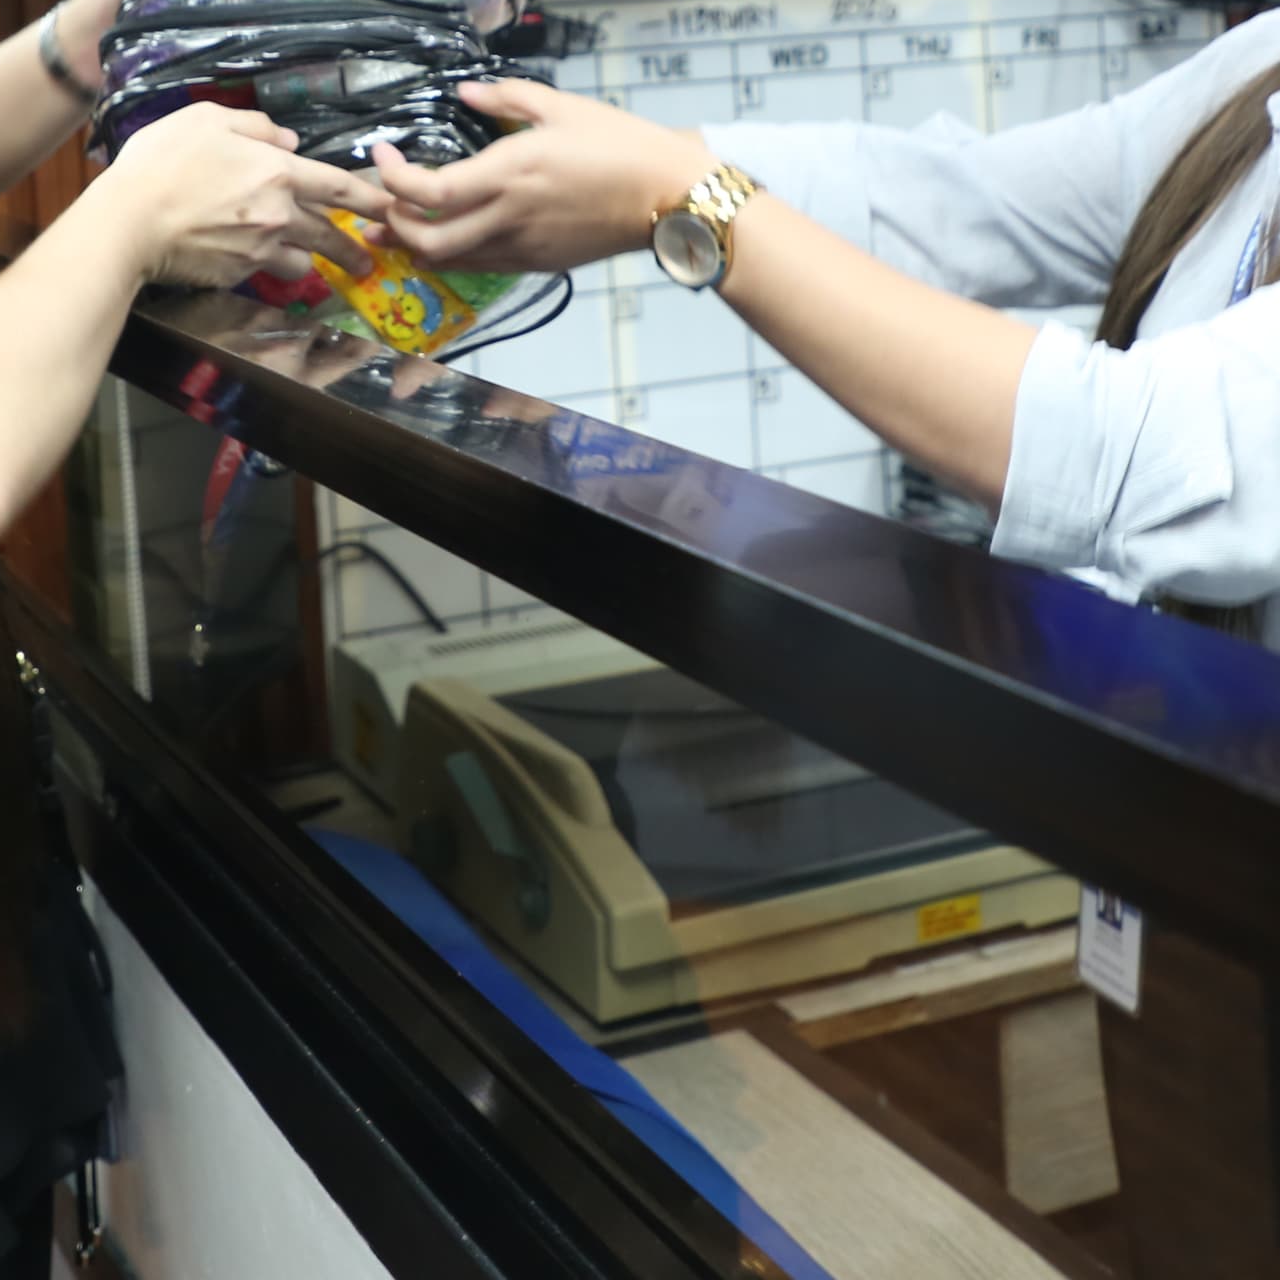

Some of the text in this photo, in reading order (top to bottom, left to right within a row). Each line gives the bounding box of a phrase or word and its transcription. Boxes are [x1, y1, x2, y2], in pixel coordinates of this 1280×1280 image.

[639, 52, 690, 80] TUE
[770, 42, 829, 69] WED
[902, 32, 952, 58] THU
[1022, 26, 1061, 50] FRI
